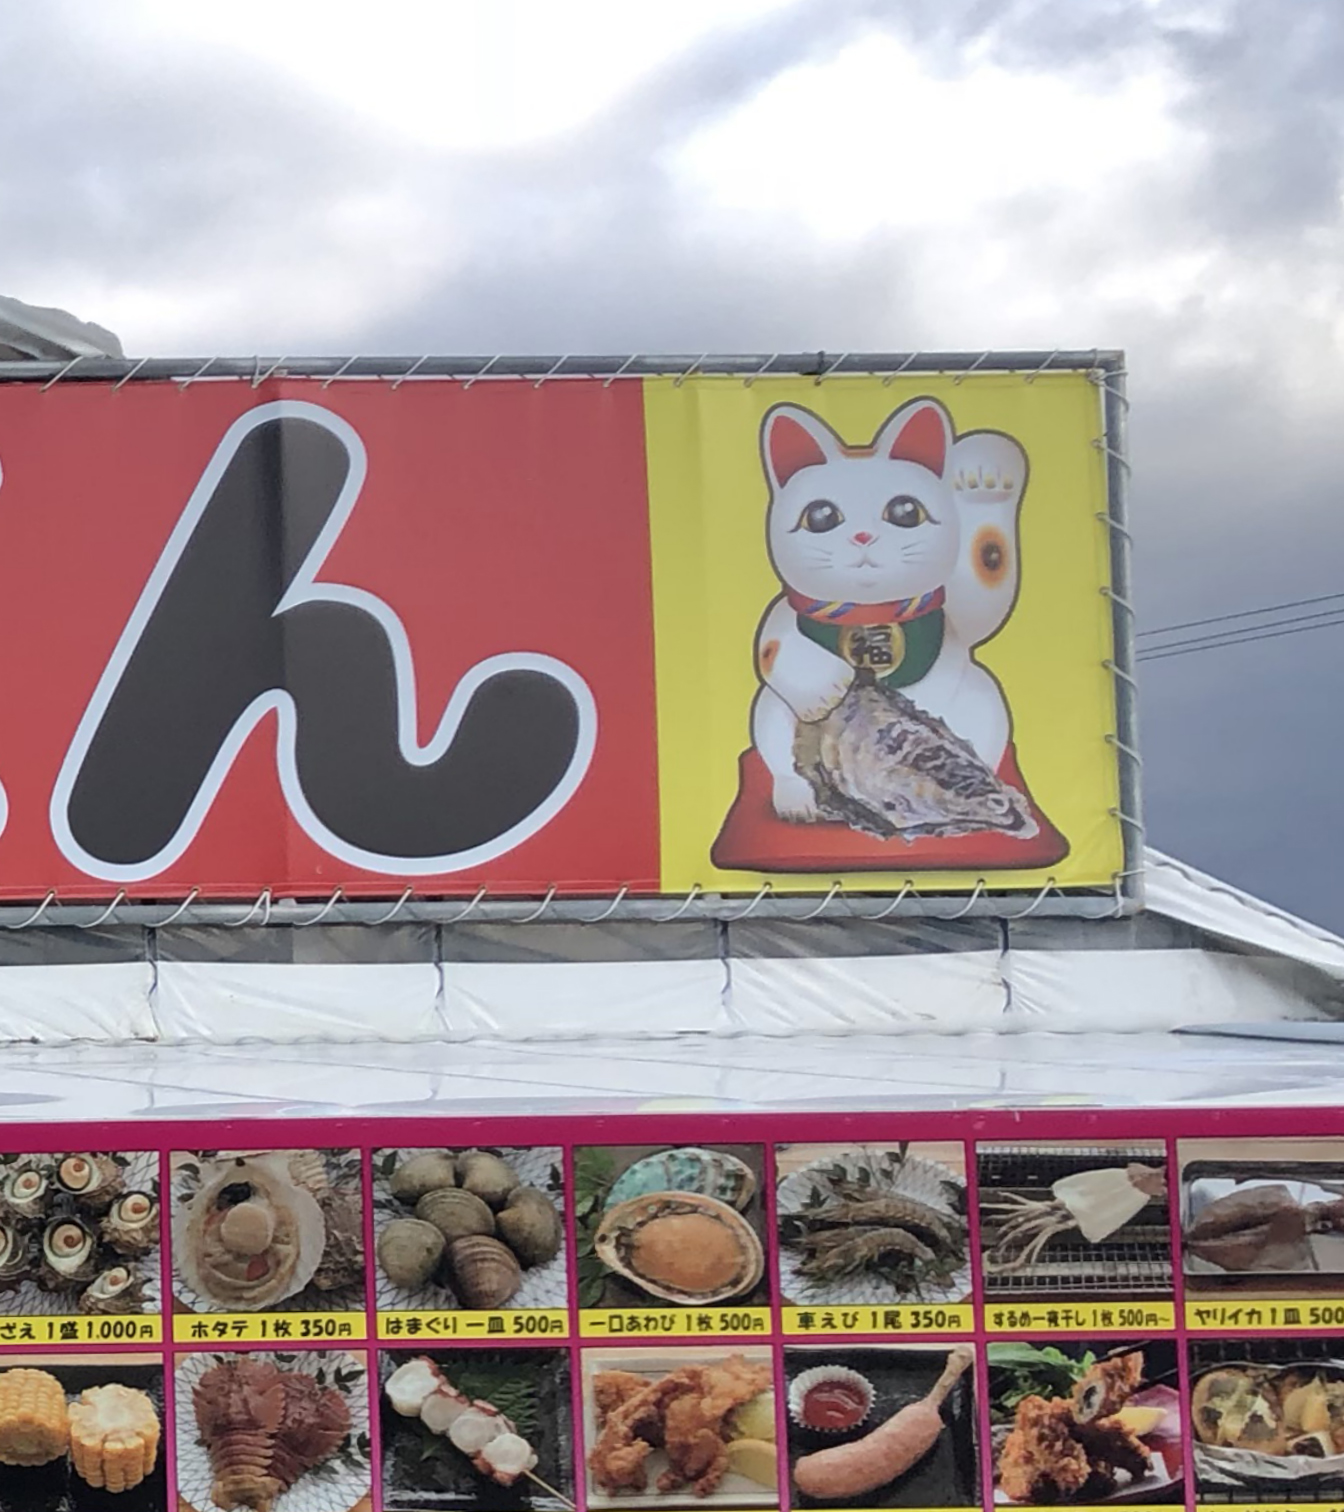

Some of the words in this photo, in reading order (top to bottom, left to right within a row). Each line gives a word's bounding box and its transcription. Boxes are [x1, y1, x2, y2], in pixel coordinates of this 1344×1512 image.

[384, 1316, 458, 1335] はまぐり
[466, 1316, 507, 1334] 一皿
[512, 1315, 564, 1334] 500円
[589, 1314, 677, 1333] 一口あわび
[684, 1314, 713, 1332] 1枚
[719, 1313, 766, 1331] 500円
[797, 1311, 862, 1331] 車えび
[869, 1310, 905, 1330] 1尾
[909, 1310, 962, 1329] 350円
[992, 1309, 1087, 1328] するめ一夜干し
[1091, 1309, 1115, 1327] 1枚
[1194, 1307, 1263, 1326] ヤリイカ
[1270, 1307, 1302, 1325] 1皿
[46, 1321, 81, 1340] 1盛
[189, 1320, 250, 1343] ホタテ
[258, 1319, 293, 1338] 1枚
[298, 1318, 353, 1342] 350円
